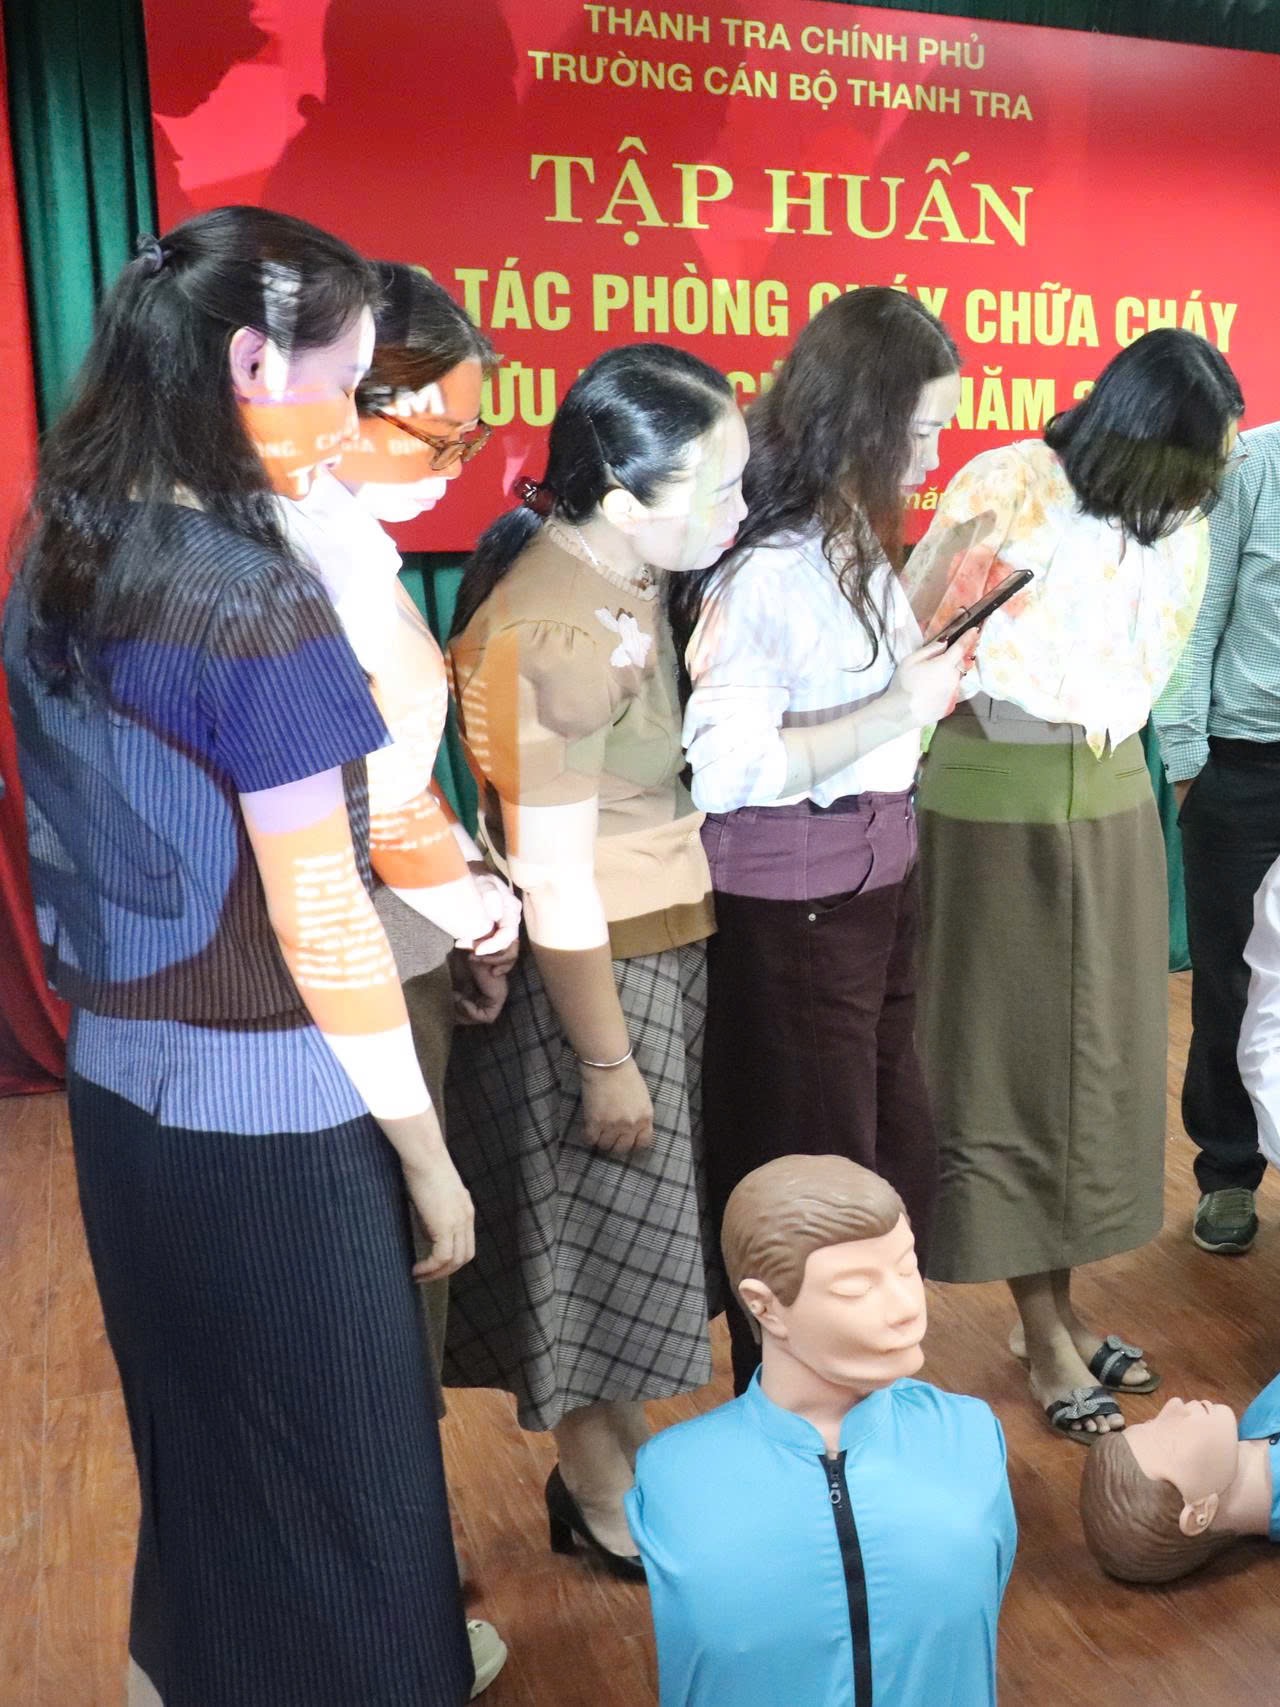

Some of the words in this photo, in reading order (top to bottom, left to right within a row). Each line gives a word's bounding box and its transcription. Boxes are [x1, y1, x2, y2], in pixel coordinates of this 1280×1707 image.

[584, 4, 711, 42] THANH
[722, 18, 790, 51] TRA
[801, 25, 907, 61] CHÍNH
[919, 32, 985, 70] PHỦ
[528, 50, 692, 92] TRƯỜNG
[704, 62, 777, 98] CÁN
[789, 69, 837, 110] BỘ
[847, 79, 960, 114] THANH
[970, 90, 1033, 121] TRA
[530, 136, 733, 246] TẬP
[764, 151, 1034, 247] HUẤN
[454, 257, 571, 331] TÁC
[592, 263, 789, 337] PHÒNG
[965, 282, 1100, 347] CHỮA
[1115, 289, 1238, 353] CHÁY
[943, 365, 1056, 431] NĂM
